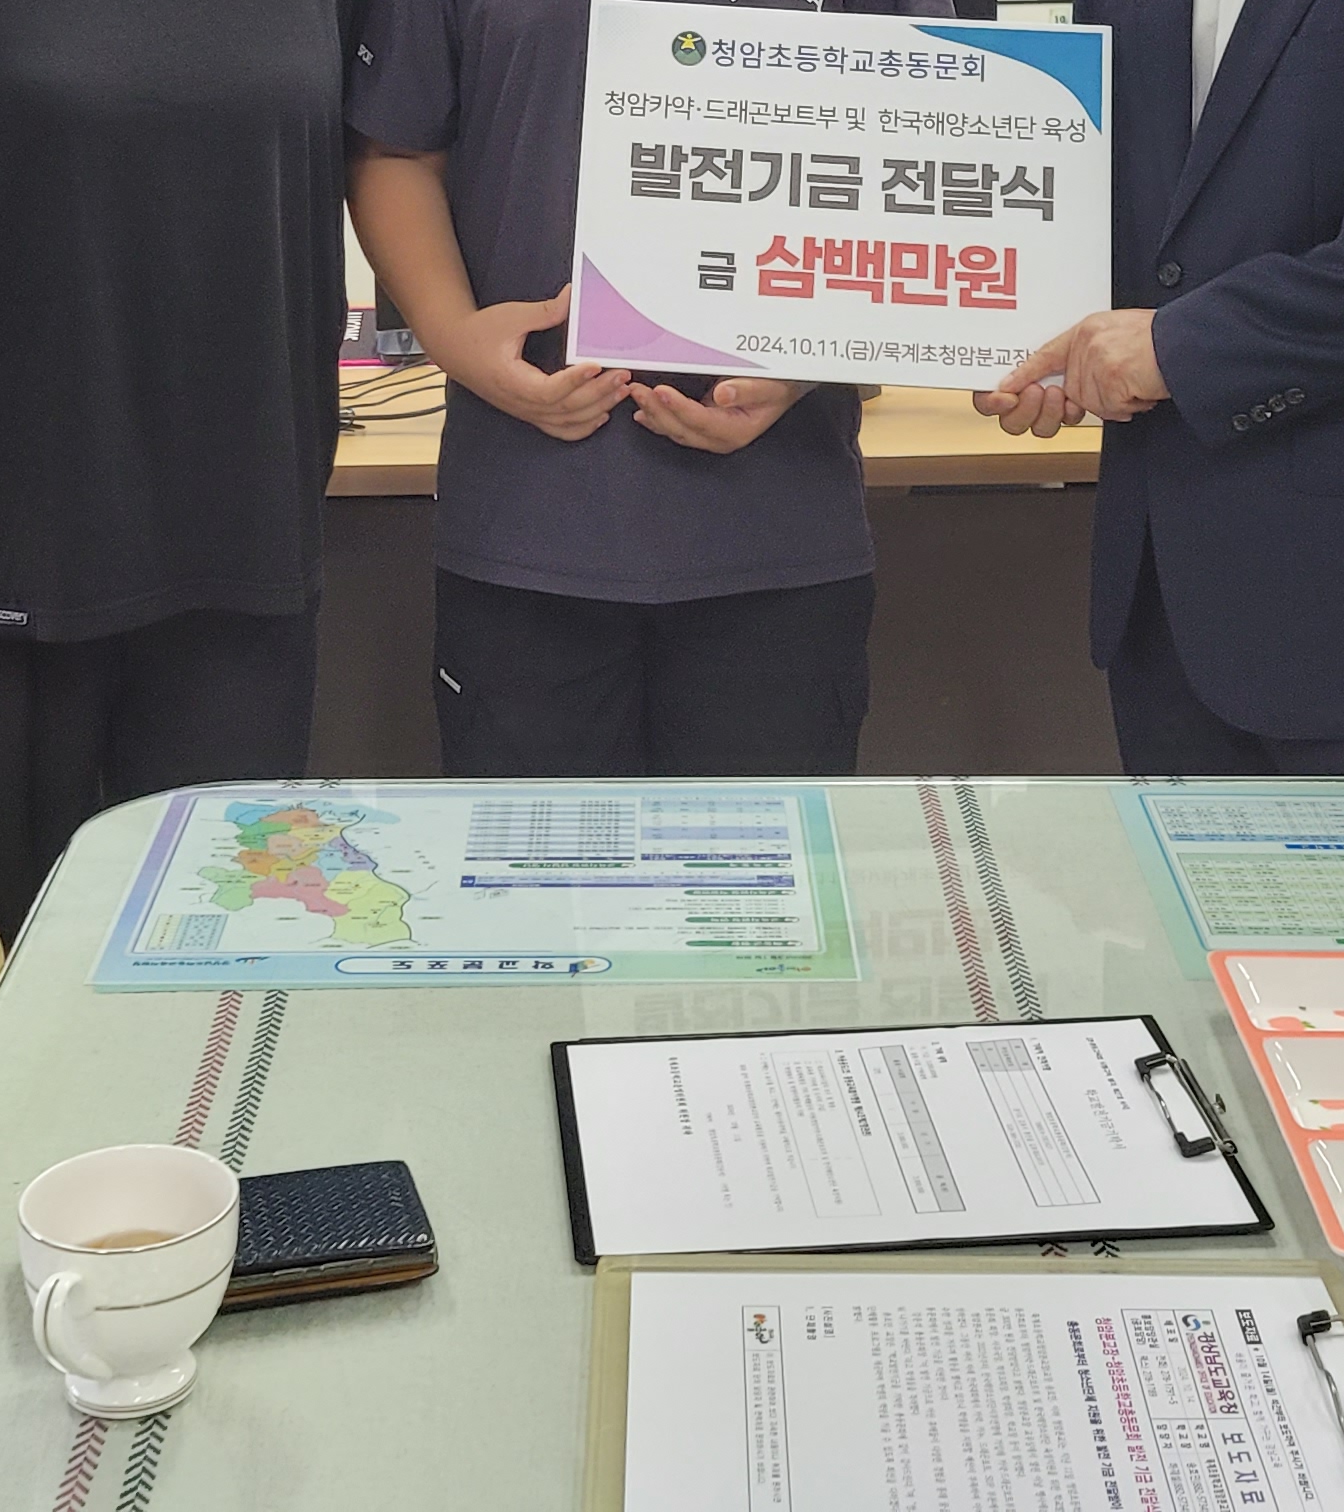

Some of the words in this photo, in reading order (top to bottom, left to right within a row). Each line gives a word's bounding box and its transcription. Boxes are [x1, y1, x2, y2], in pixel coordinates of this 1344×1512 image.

[709, 38, 988, 83] 청암초등학교총동문회
[603, 90, 839, 131] 청암카약·드래곤보트부
[845, 107, 867, 133] 및
[877, 108, 1037, 141] 한국해양소년단
[1040, 116, 1088, 143] 육성
[629, 142, 864, 212] 발전기금
[879, 157, 1057, 223] 전달식
[696, 250, 738, 292] 금
[754, 234, 1019, 311] 삼백만원
